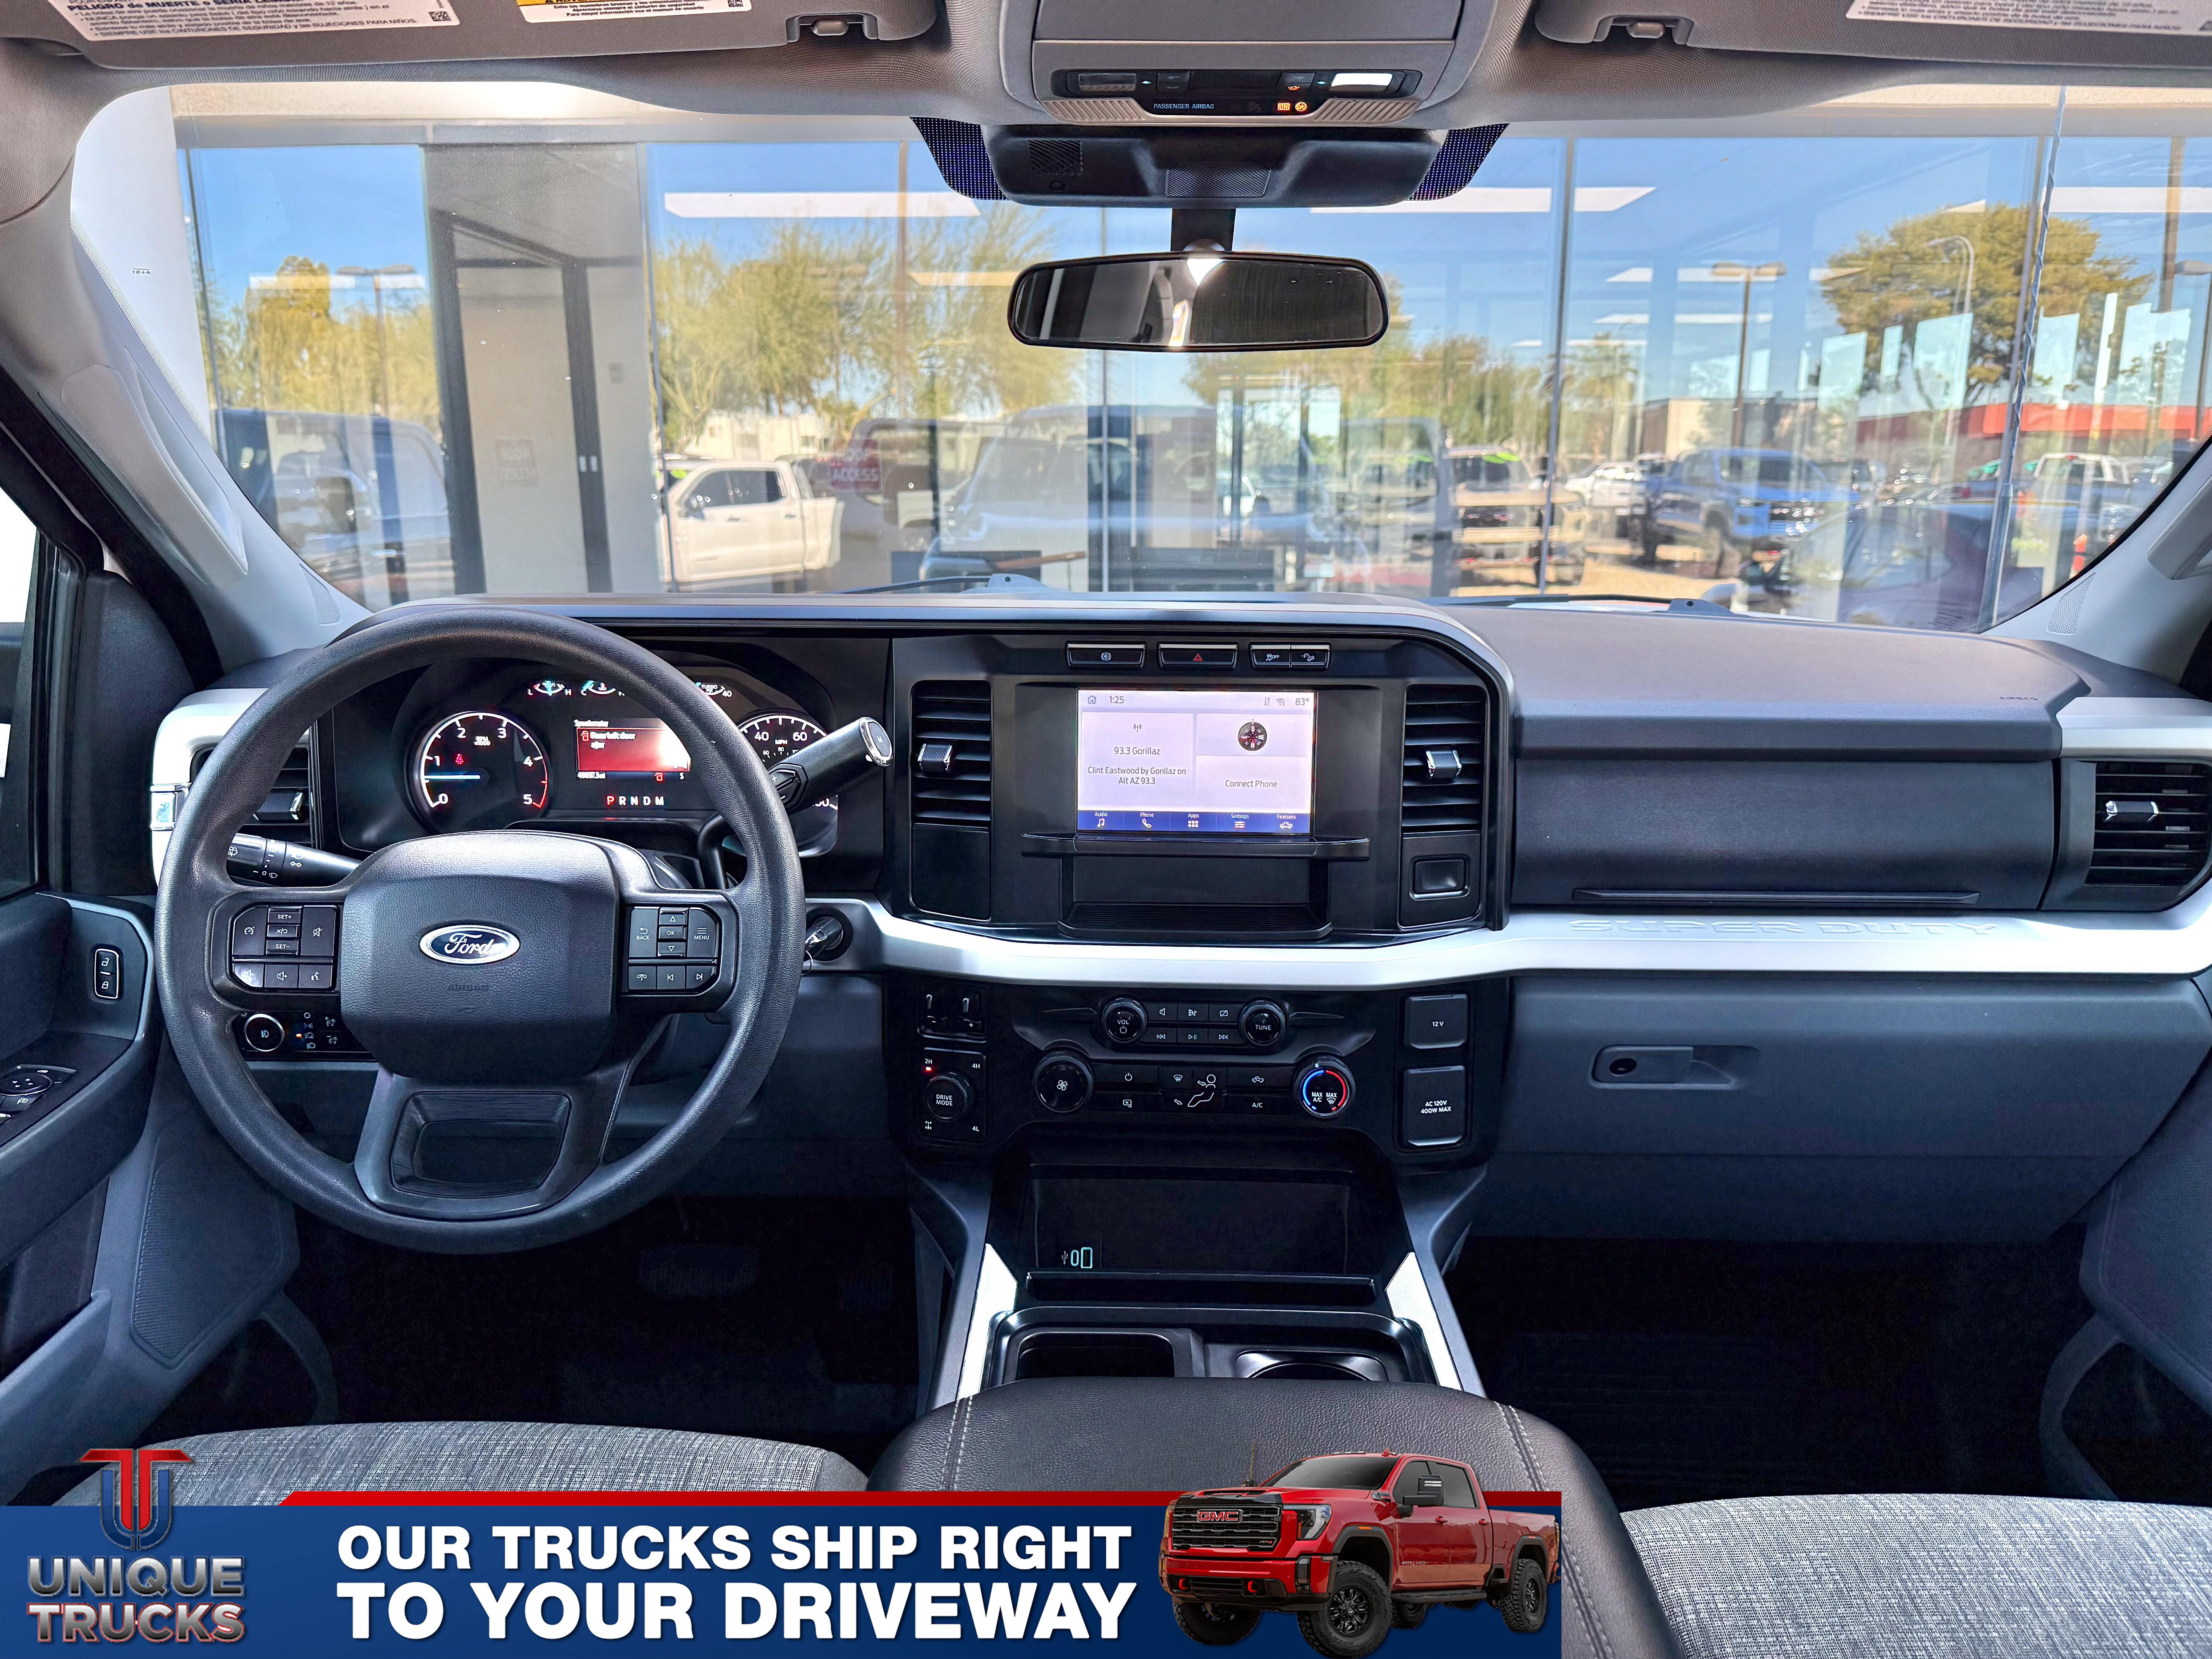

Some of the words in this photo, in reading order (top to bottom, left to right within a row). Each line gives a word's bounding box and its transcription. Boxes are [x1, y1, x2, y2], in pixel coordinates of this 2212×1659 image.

[832, 469, 880, 482] ACCESS
[1109, 696, 1124, 704] 1:25
[574, 719, 609, 728] Speedometer
[457, 727, 466, 738] 2
[498, 727, 507, 738] 3
[620, 732, 636, 740] door
[754, 732, 769, 741] 40
[793, 732, 808, 741] 60
[1114, 747, 1130, 755] 93.3
[1132, 747, 1161, 755] Gorillaz
[434, 756, 440, 766] 1
[524, 756, 533, 767] 4
[1140, 767, 1149, 775] by
[1225, 780, 1253, 788] Connect
[438, 793, 448, 804] 0
[523, 794, 533, 805] 5
[607, 796, 615, 805] P
[618, 796, 627, 806] R
[630, 796, 639, 805] N
[643, 796, 651, 806] D
[655, 796, 664, 806] M
[1569, 919, 1803, 935] SUPER
[1817, 921, 1999, 935] DUTY
[444, 933, 495, 955] Ford
